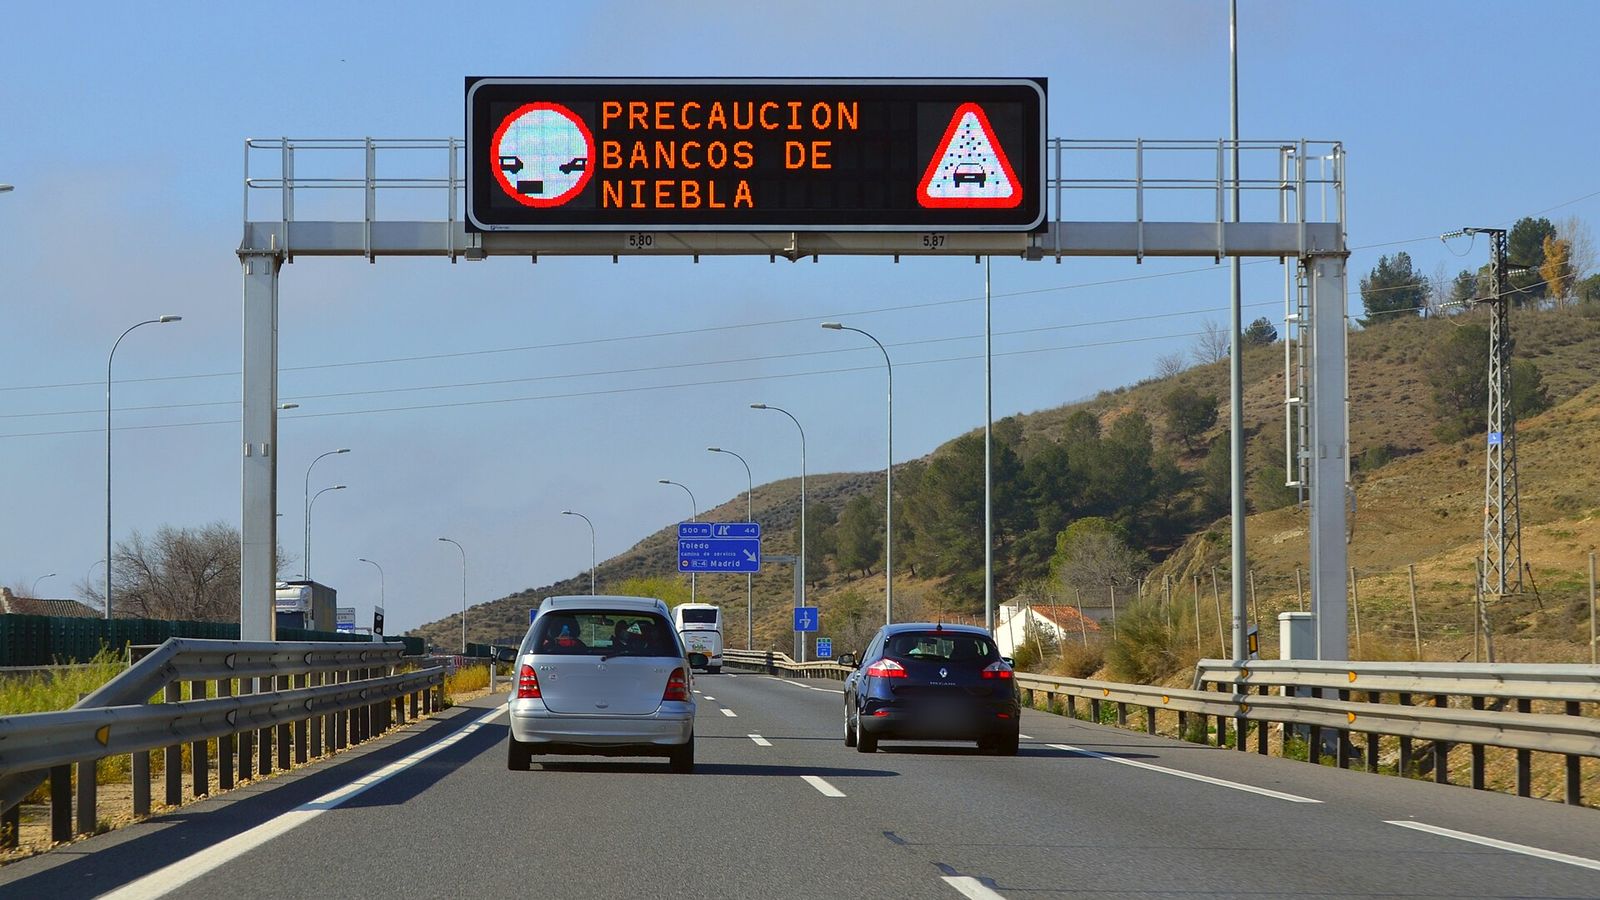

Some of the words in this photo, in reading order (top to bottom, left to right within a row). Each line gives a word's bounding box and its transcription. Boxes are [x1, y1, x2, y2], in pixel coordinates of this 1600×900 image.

[602, 101, 859, 130] PRECAUCION
[602, 141, 754, 169] BANCOS
[785, 141, 832, 169] DE
[602, 180, 754, 208] NIEBLA
